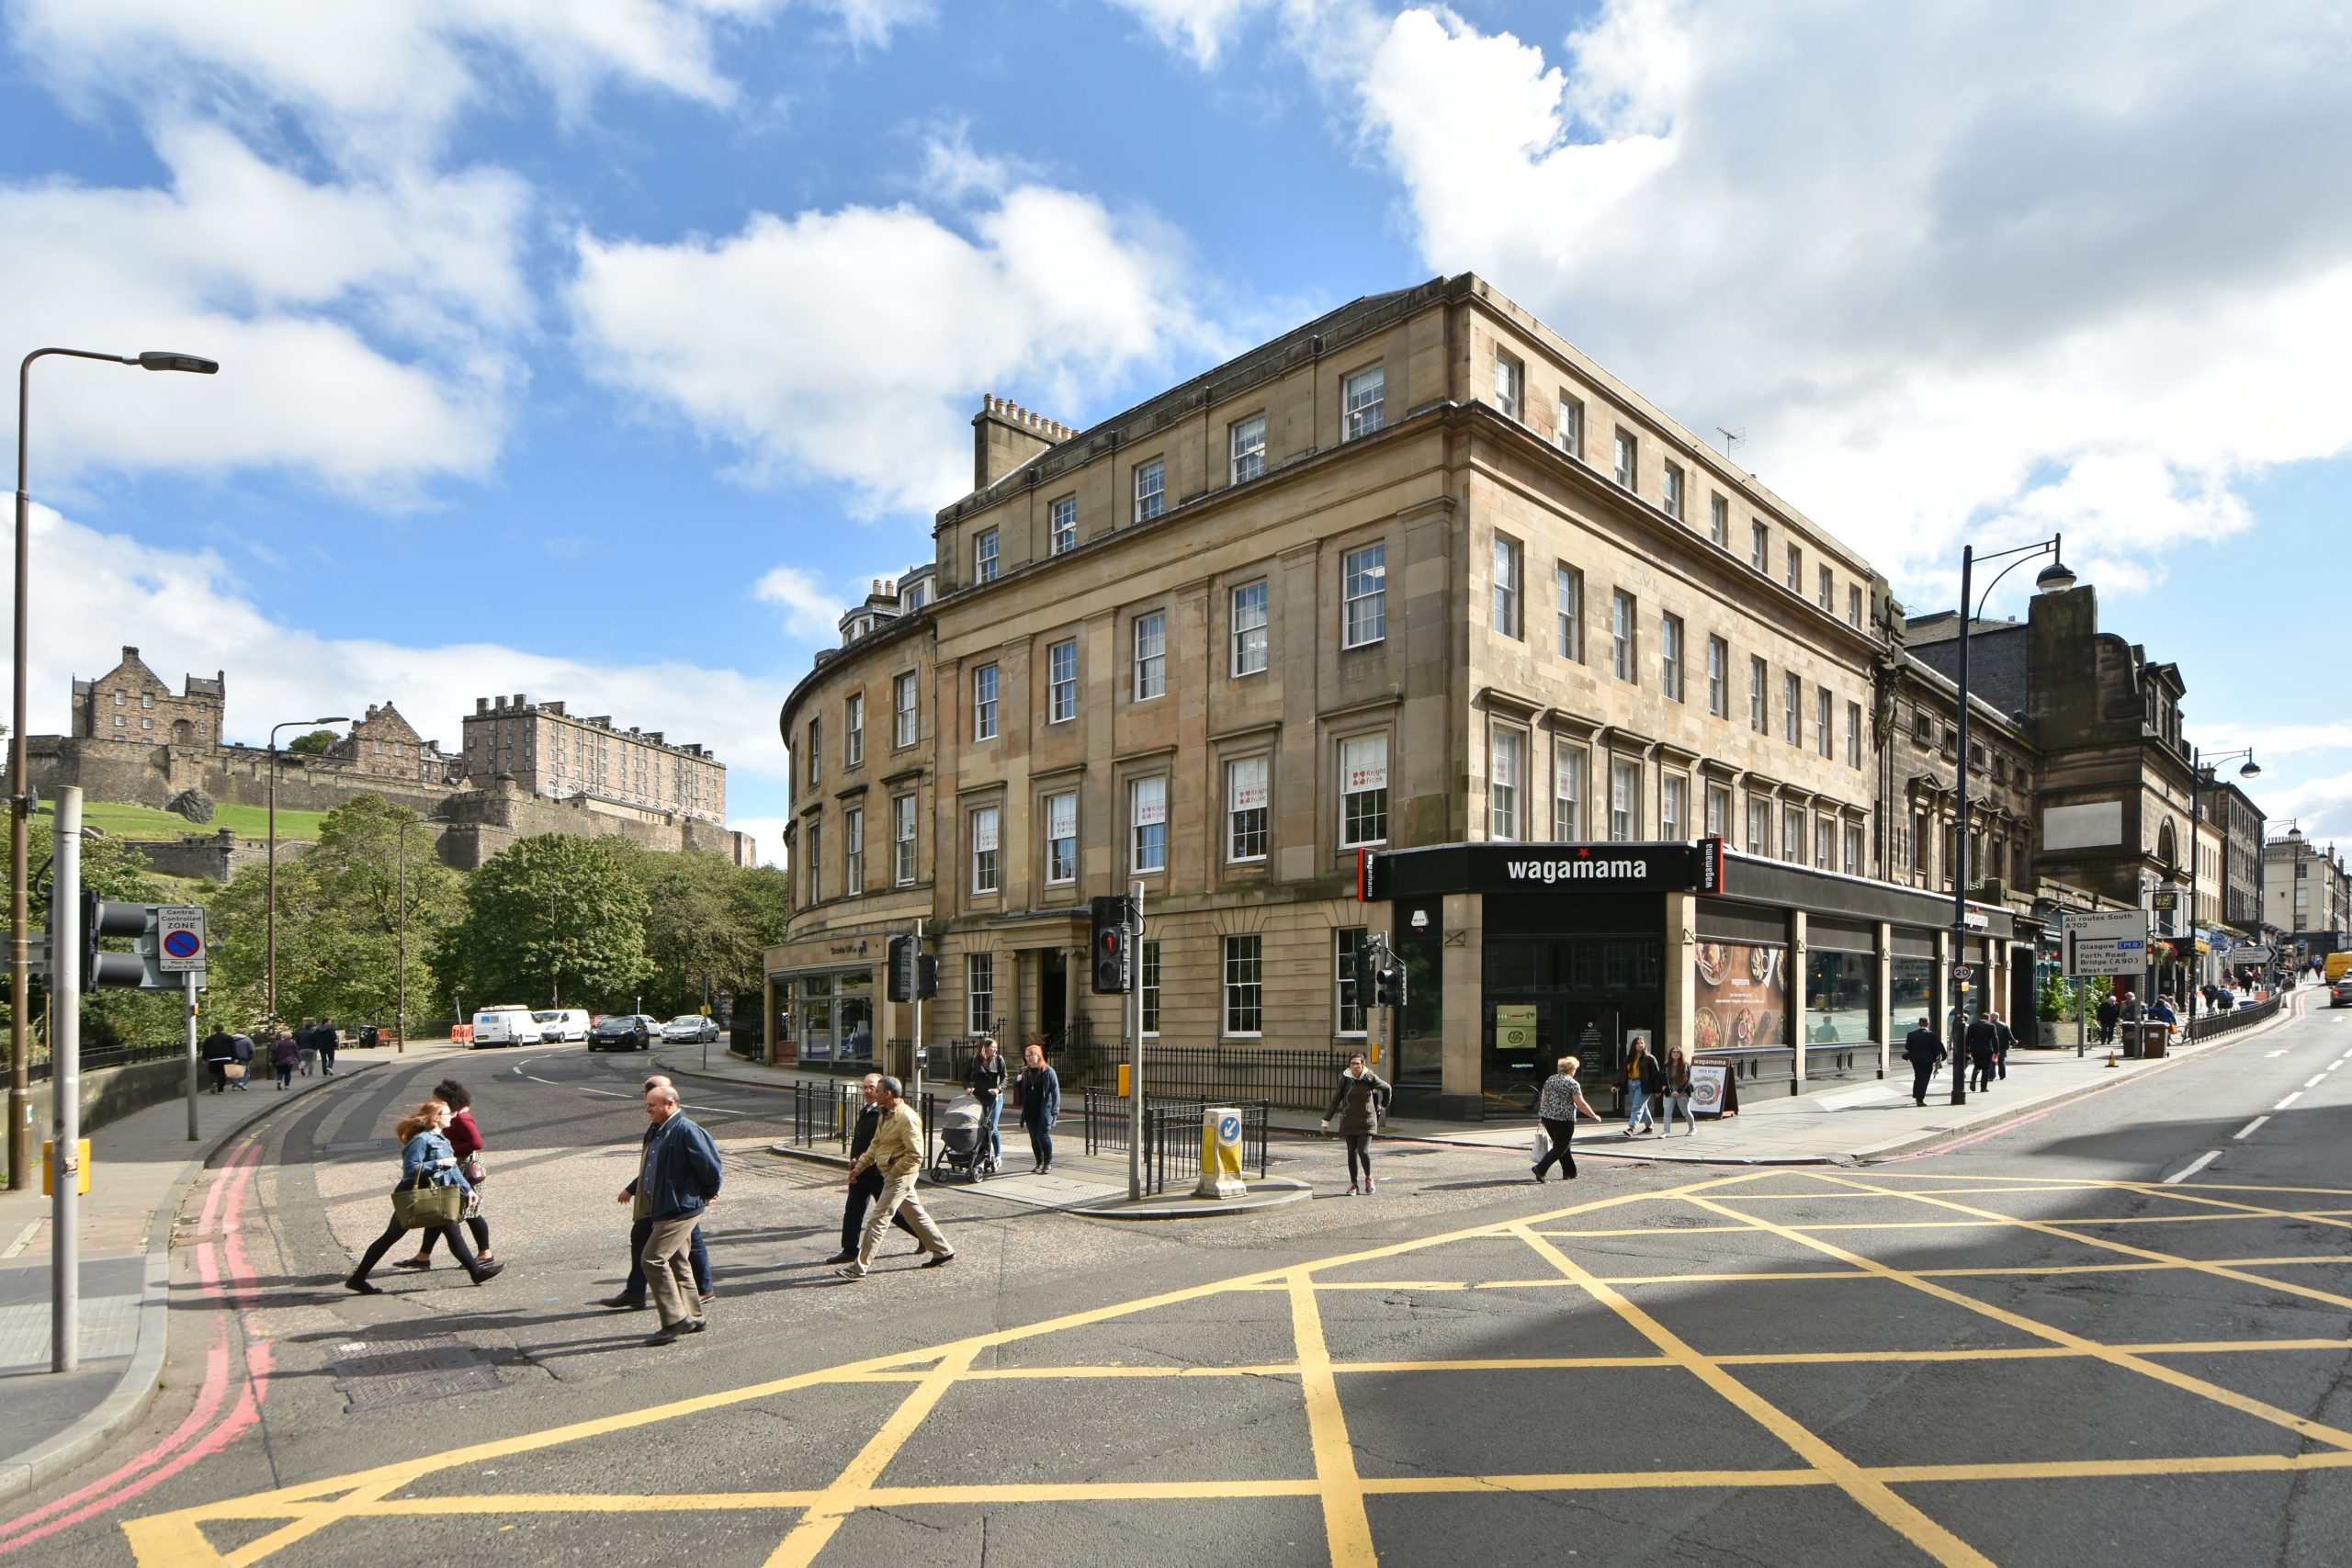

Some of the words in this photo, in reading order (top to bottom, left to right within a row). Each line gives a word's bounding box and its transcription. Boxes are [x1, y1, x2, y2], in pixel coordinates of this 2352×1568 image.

[1367, 768, 1386, 777] Knight
[1508, 860, 1647, 884] wagamama
[1705, 843, 1714, 889] wagamama
